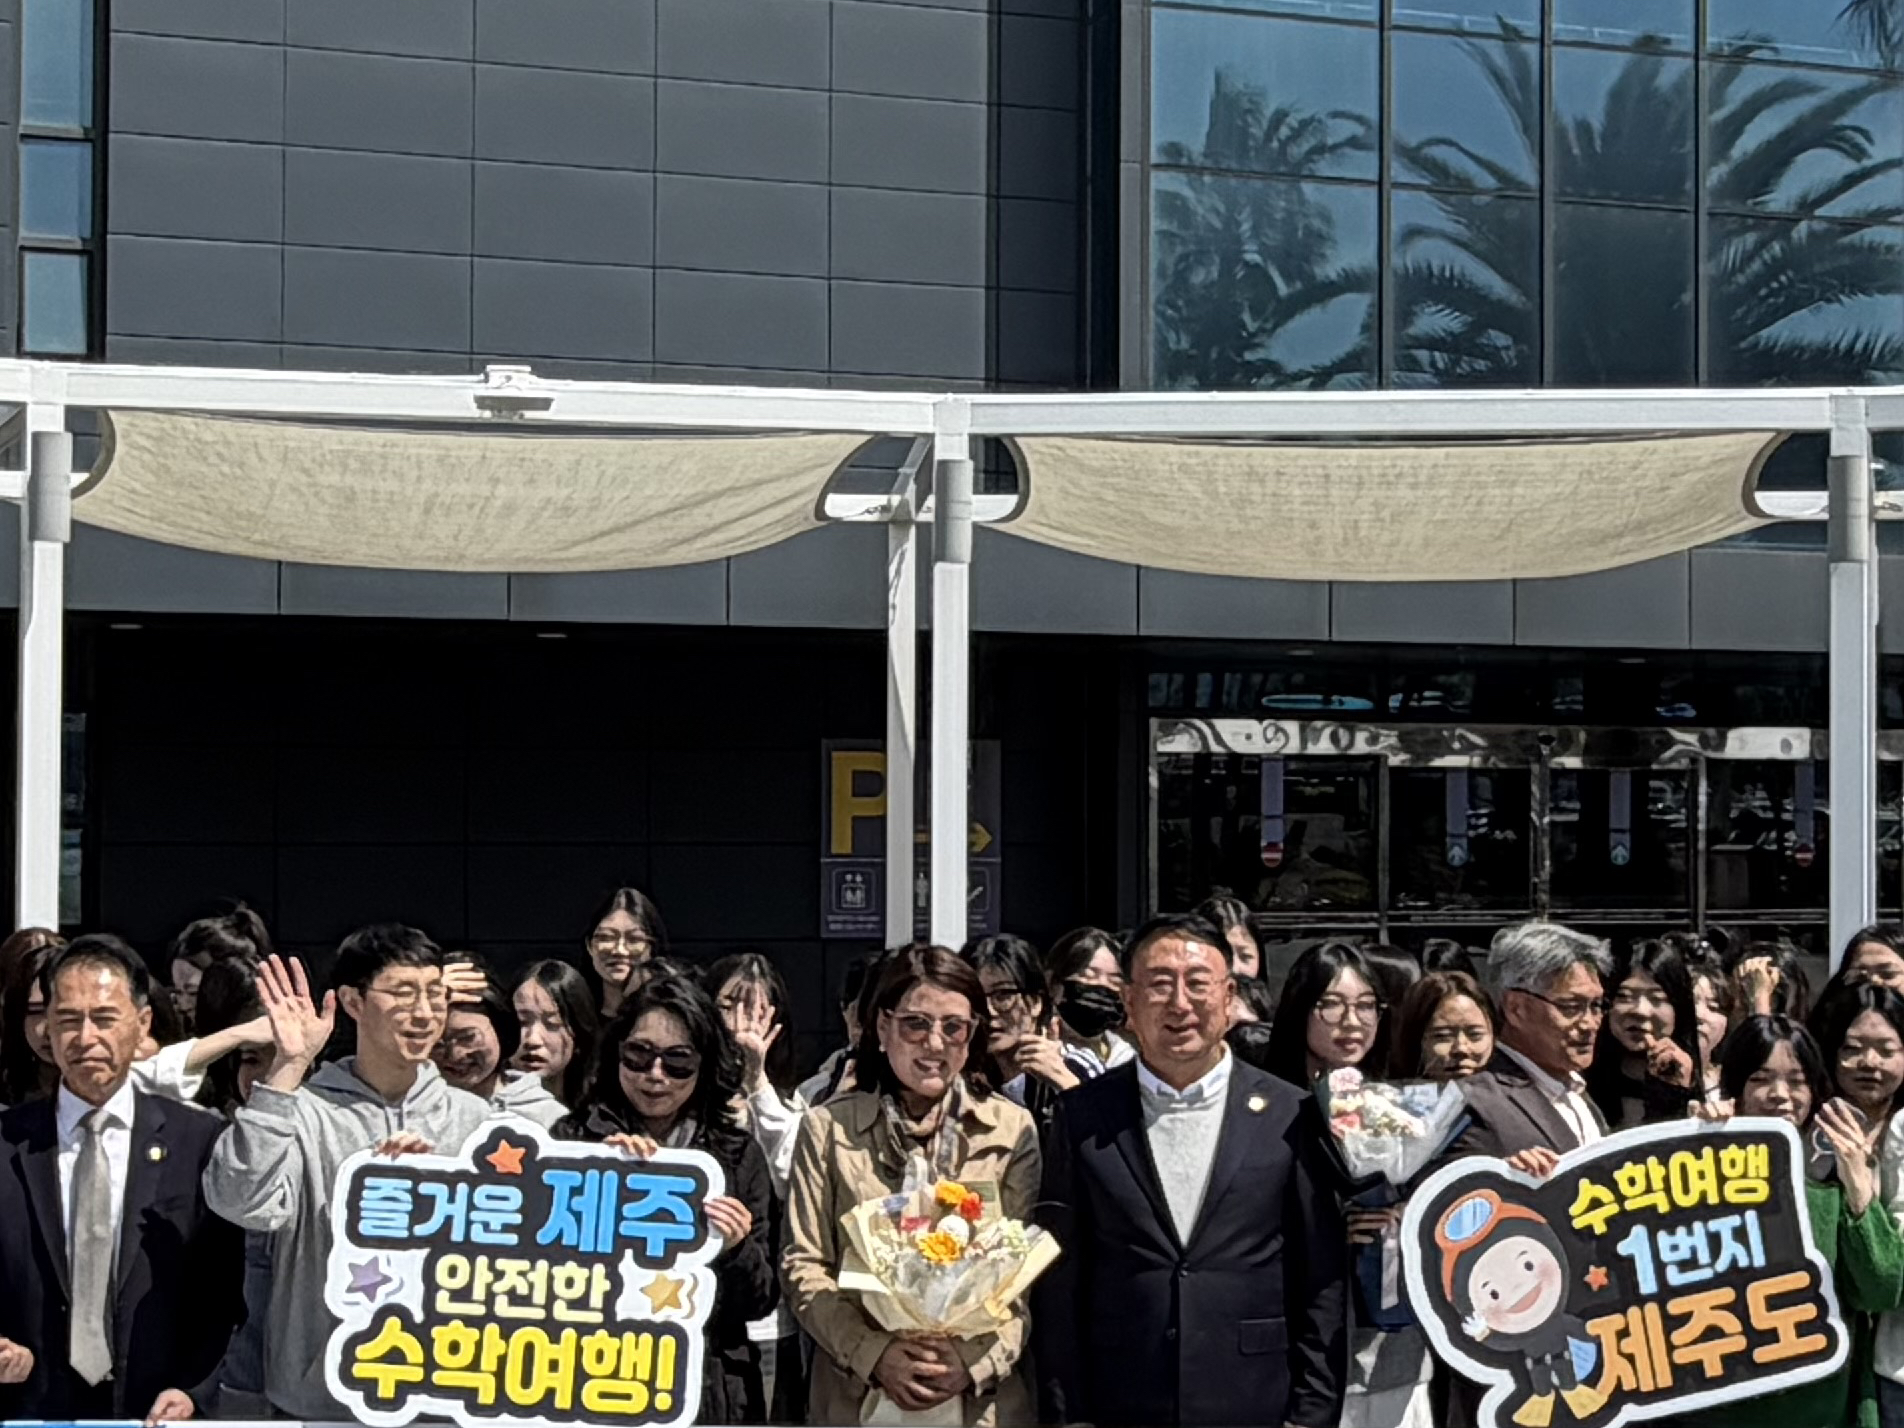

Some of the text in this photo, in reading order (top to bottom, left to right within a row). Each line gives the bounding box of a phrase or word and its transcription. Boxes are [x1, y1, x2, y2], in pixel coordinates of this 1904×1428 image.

[831, 751, 888, 855] P
[358, 1168, 697, 1258] 즐거운 제주
[1568, 1143, 1771, 1235] 수학여행
[434, 1254, 612, 1323] 안전한
[1616, 1209, 1767, 1296] 1번지
[351, 1316, 677, 1414] 수학여행!
[1585, 1270, 1829, 1394] 제주도
